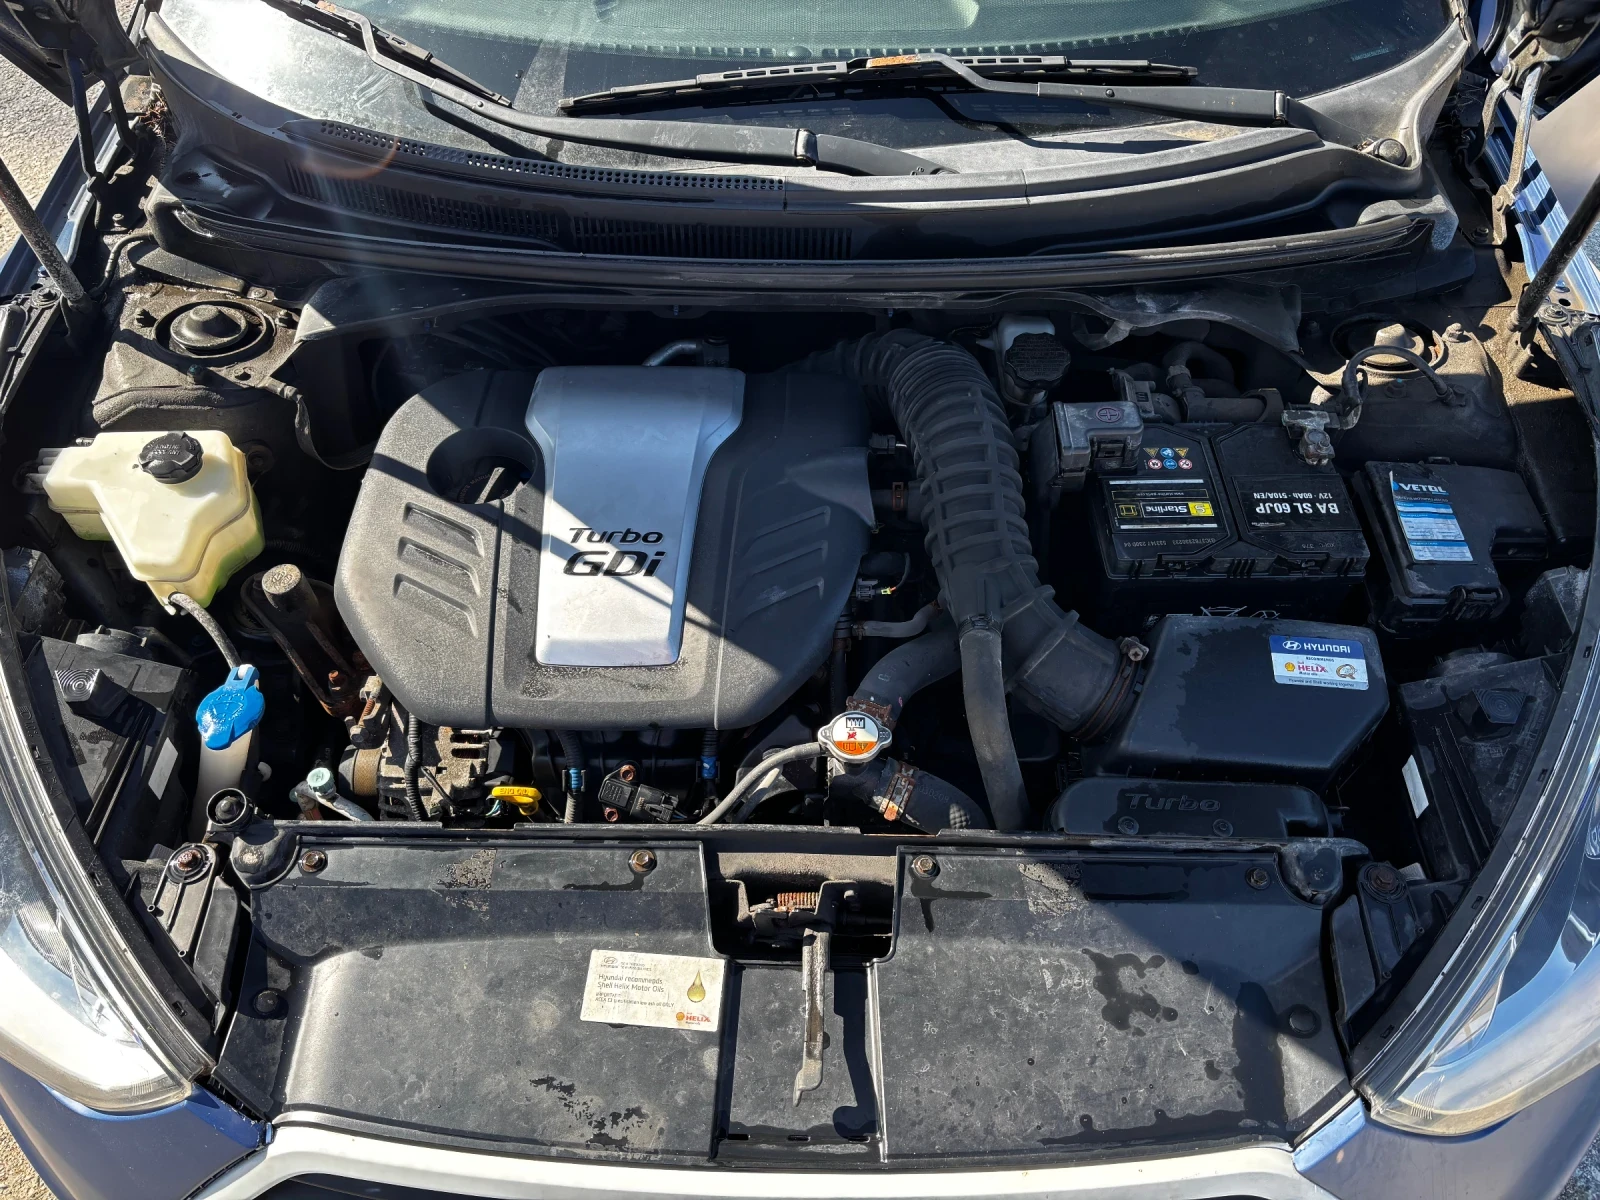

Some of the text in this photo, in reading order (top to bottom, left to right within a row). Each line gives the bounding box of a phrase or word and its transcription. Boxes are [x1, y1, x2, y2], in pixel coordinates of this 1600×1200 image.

[1253, 491, 1287, 499] 510A/EN
[1145, 504, 1187, 514] Starline
[1255, 502, 1340, 514] BA SL 60JP
[569, 527, 664, 544] Turbo
[563, 550, 667, 577] GDi
[1303, 642, 1351, 654] HYUNDAI
[1297, 664, 1327, 673] HELIX
[1125, 793, 1220, 811] Turbo
[598, 974, 663, 985] Hyundai recommends
[597, 981, 613, 989] Shell
[613, 982, 630, 990] Helix
[652, 985, 665, 993] Oils
[685, 1015, 710, 1023] HELIX
